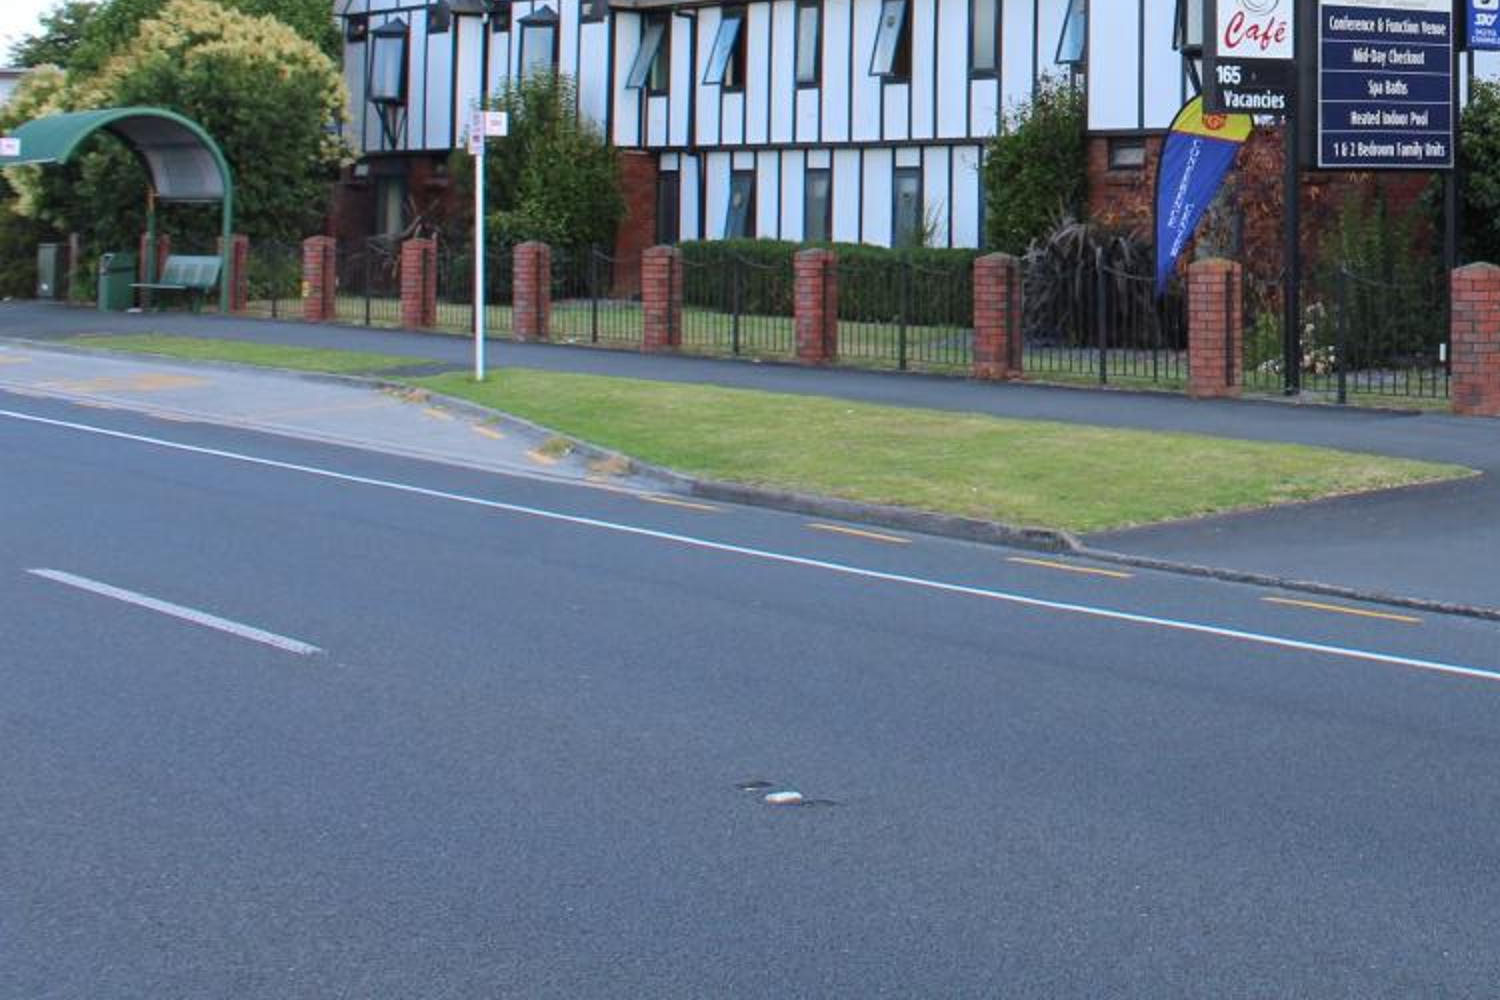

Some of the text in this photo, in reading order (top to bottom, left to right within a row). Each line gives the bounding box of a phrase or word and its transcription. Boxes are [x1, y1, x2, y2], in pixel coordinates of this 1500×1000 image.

[1225, 11, 1287, 50] Café
[1329, 15, 1447, 36] Conference & Function Venue
[1352, 47, 1425, 67] Mid-Day Checkout
[1216, 65, 1241, 85] 165
[1368, 79, 1408, 97] Spa Baths
[1223, 89, 1285, 108] Vacancies
[1351, 109, 1428, 126] Heated Indoor Pool
[1334, 140, 1445, 160] 1 & 2 Bedroom Family Units
